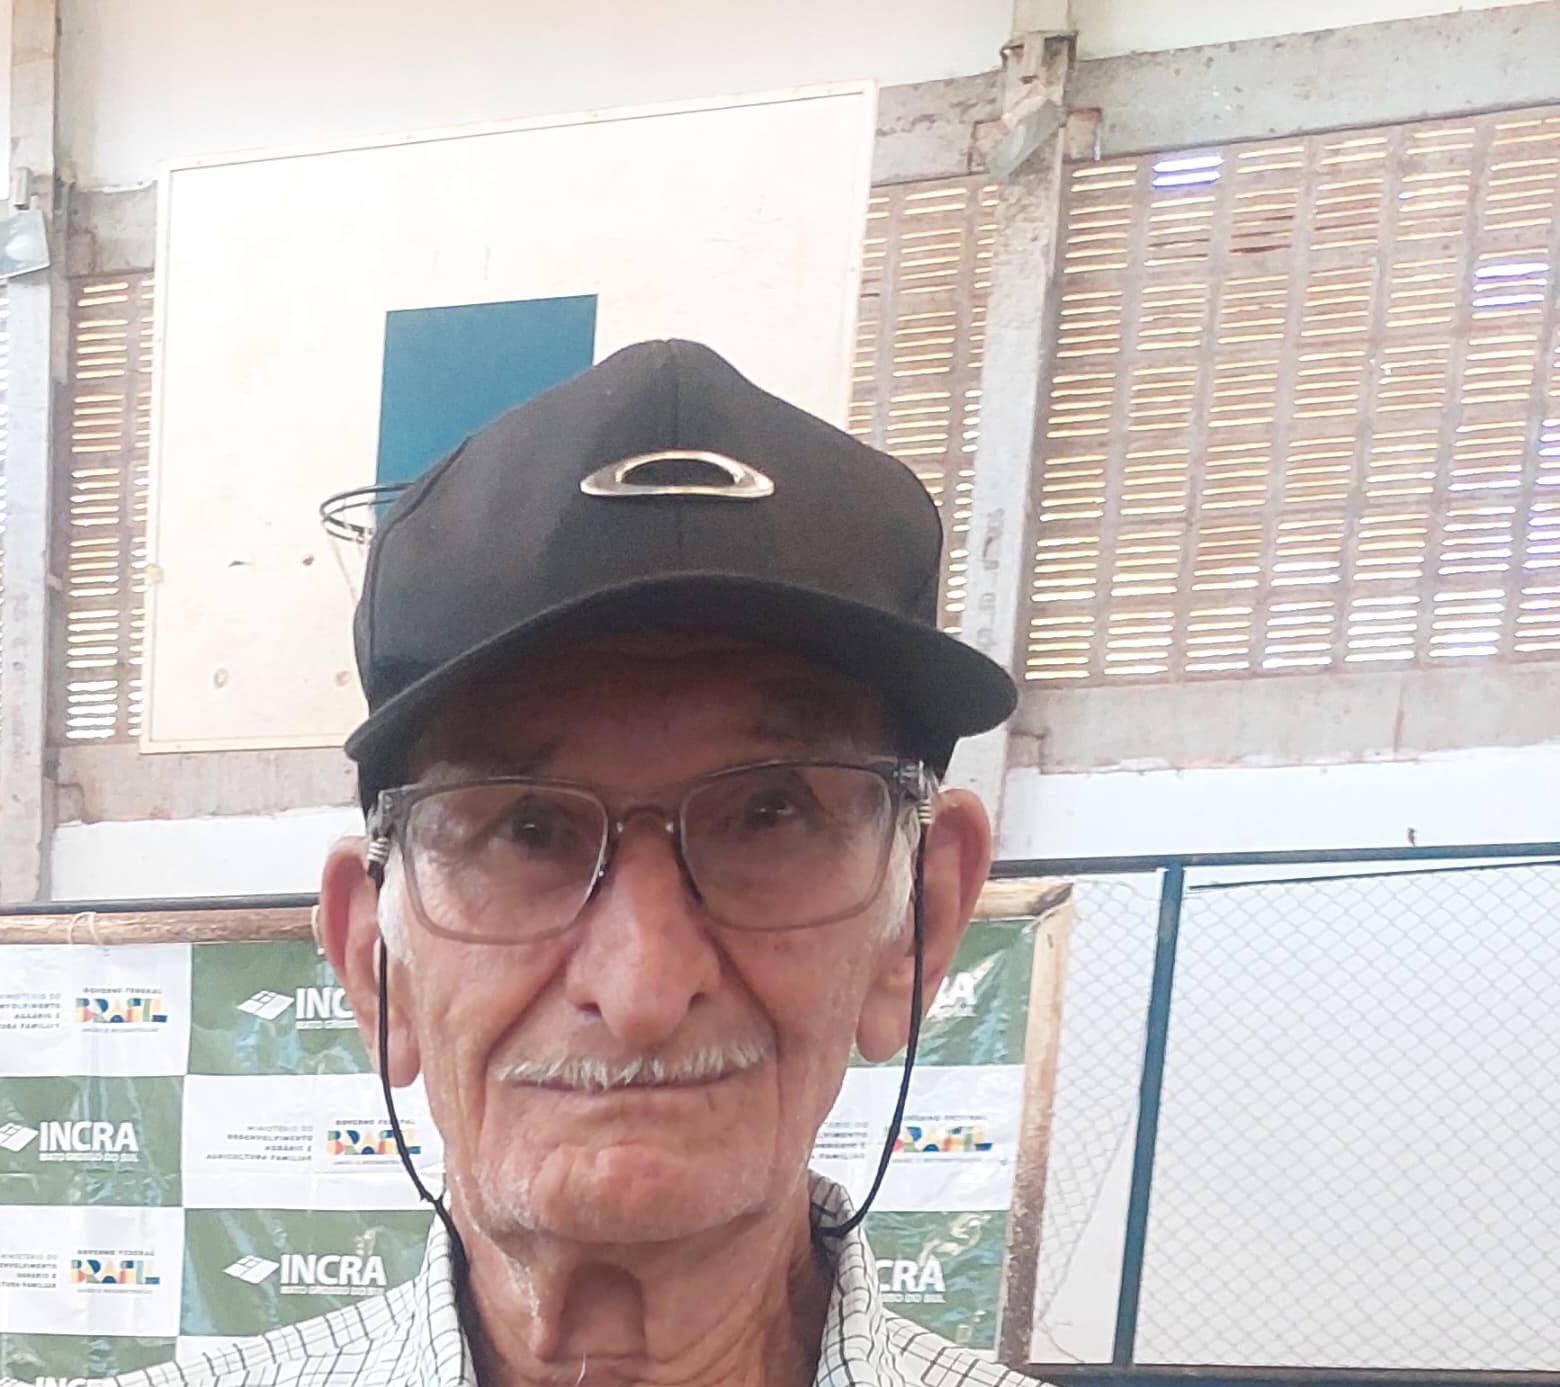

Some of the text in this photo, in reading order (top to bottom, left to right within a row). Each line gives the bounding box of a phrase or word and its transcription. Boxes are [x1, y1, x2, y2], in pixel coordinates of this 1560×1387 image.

[295, 987, 354, 1019] INC
[40, 1121, 139, 1152] INCRA
[280, 1254, 387, 1286] INCRA
